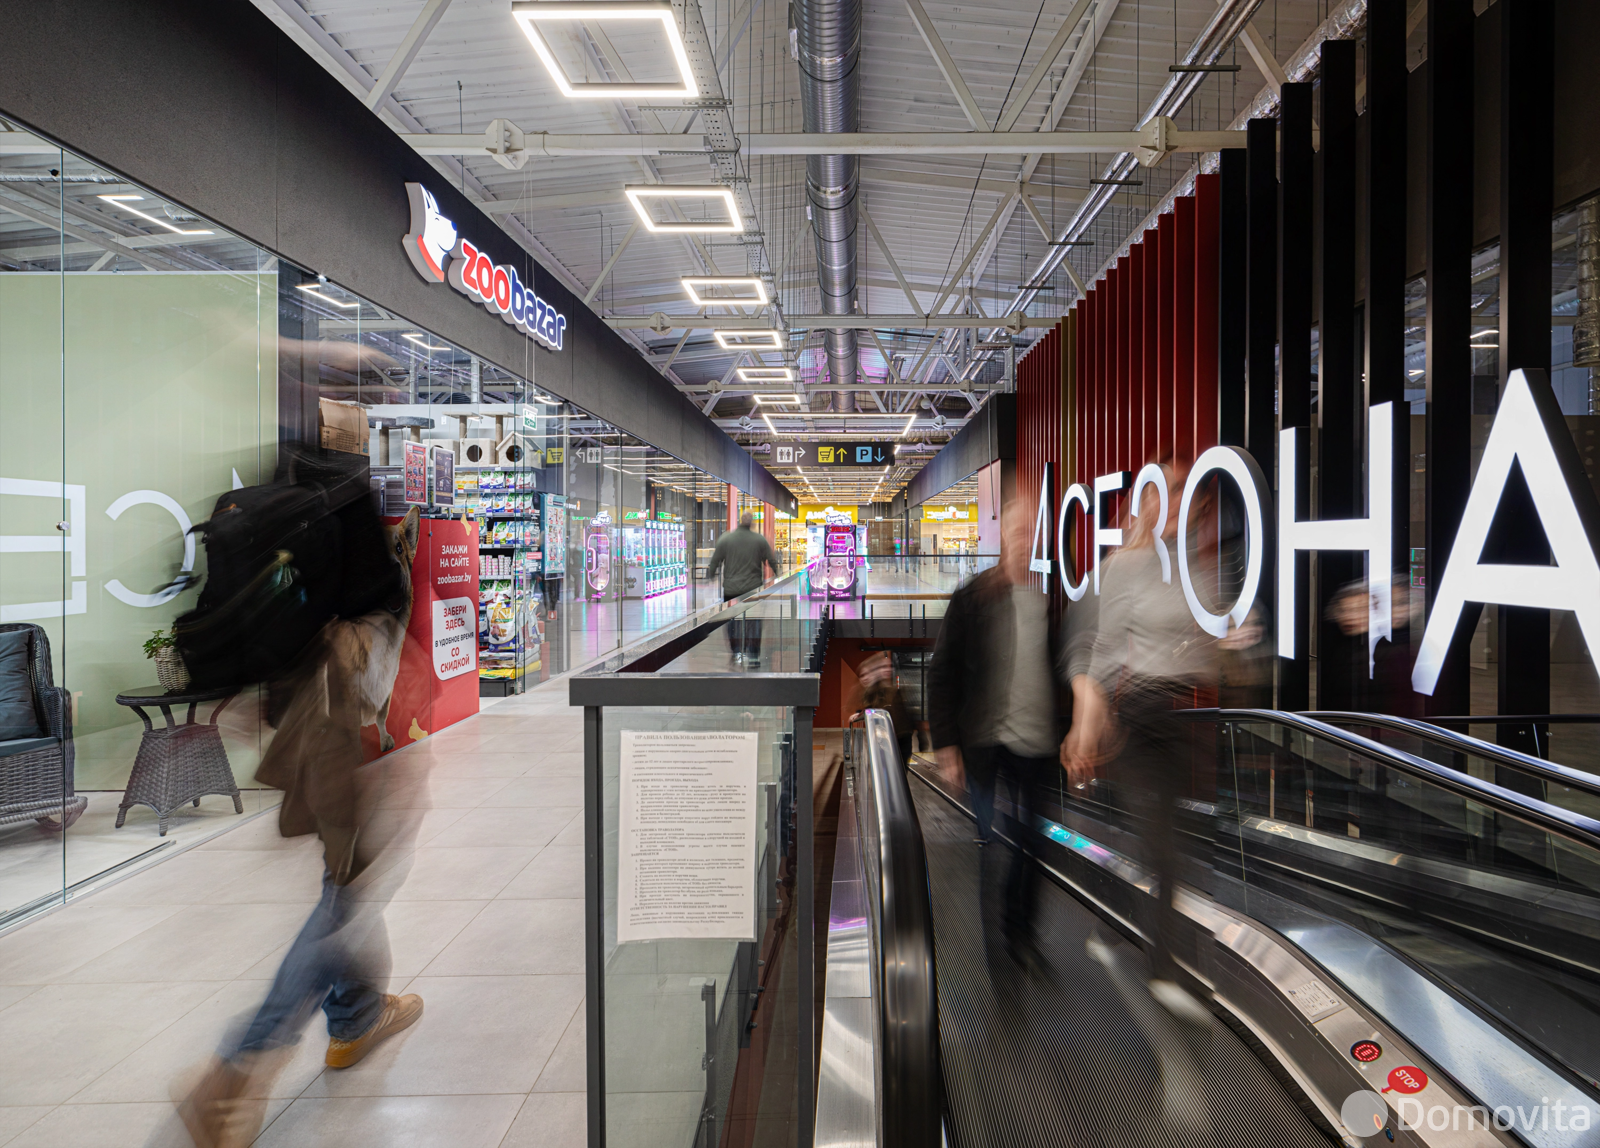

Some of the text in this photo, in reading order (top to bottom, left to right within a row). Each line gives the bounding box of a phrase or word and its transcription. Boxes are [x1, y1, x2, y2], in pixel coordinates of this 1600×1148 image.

[460, 238, 567, 351] zoobazar
[441, 545, 468, 555] ЗАКАЖИ
[439, 555, 470, 568] НА САЙТЕ
[437, 572, 472, 585] zoobazar.by
[443, 604, 467, 618] ЗАБЕРИ
[445, 618, 465, 631] ЗДЕСЬ
[434, 631, 475, 648] В УДОБНОЕ ВРЕМЯ
[450, 646, 460, 657] СО
[440, 653, 470, 673] СКИДКОЙ
[1395, 1069, 1420, 1089] STOP
